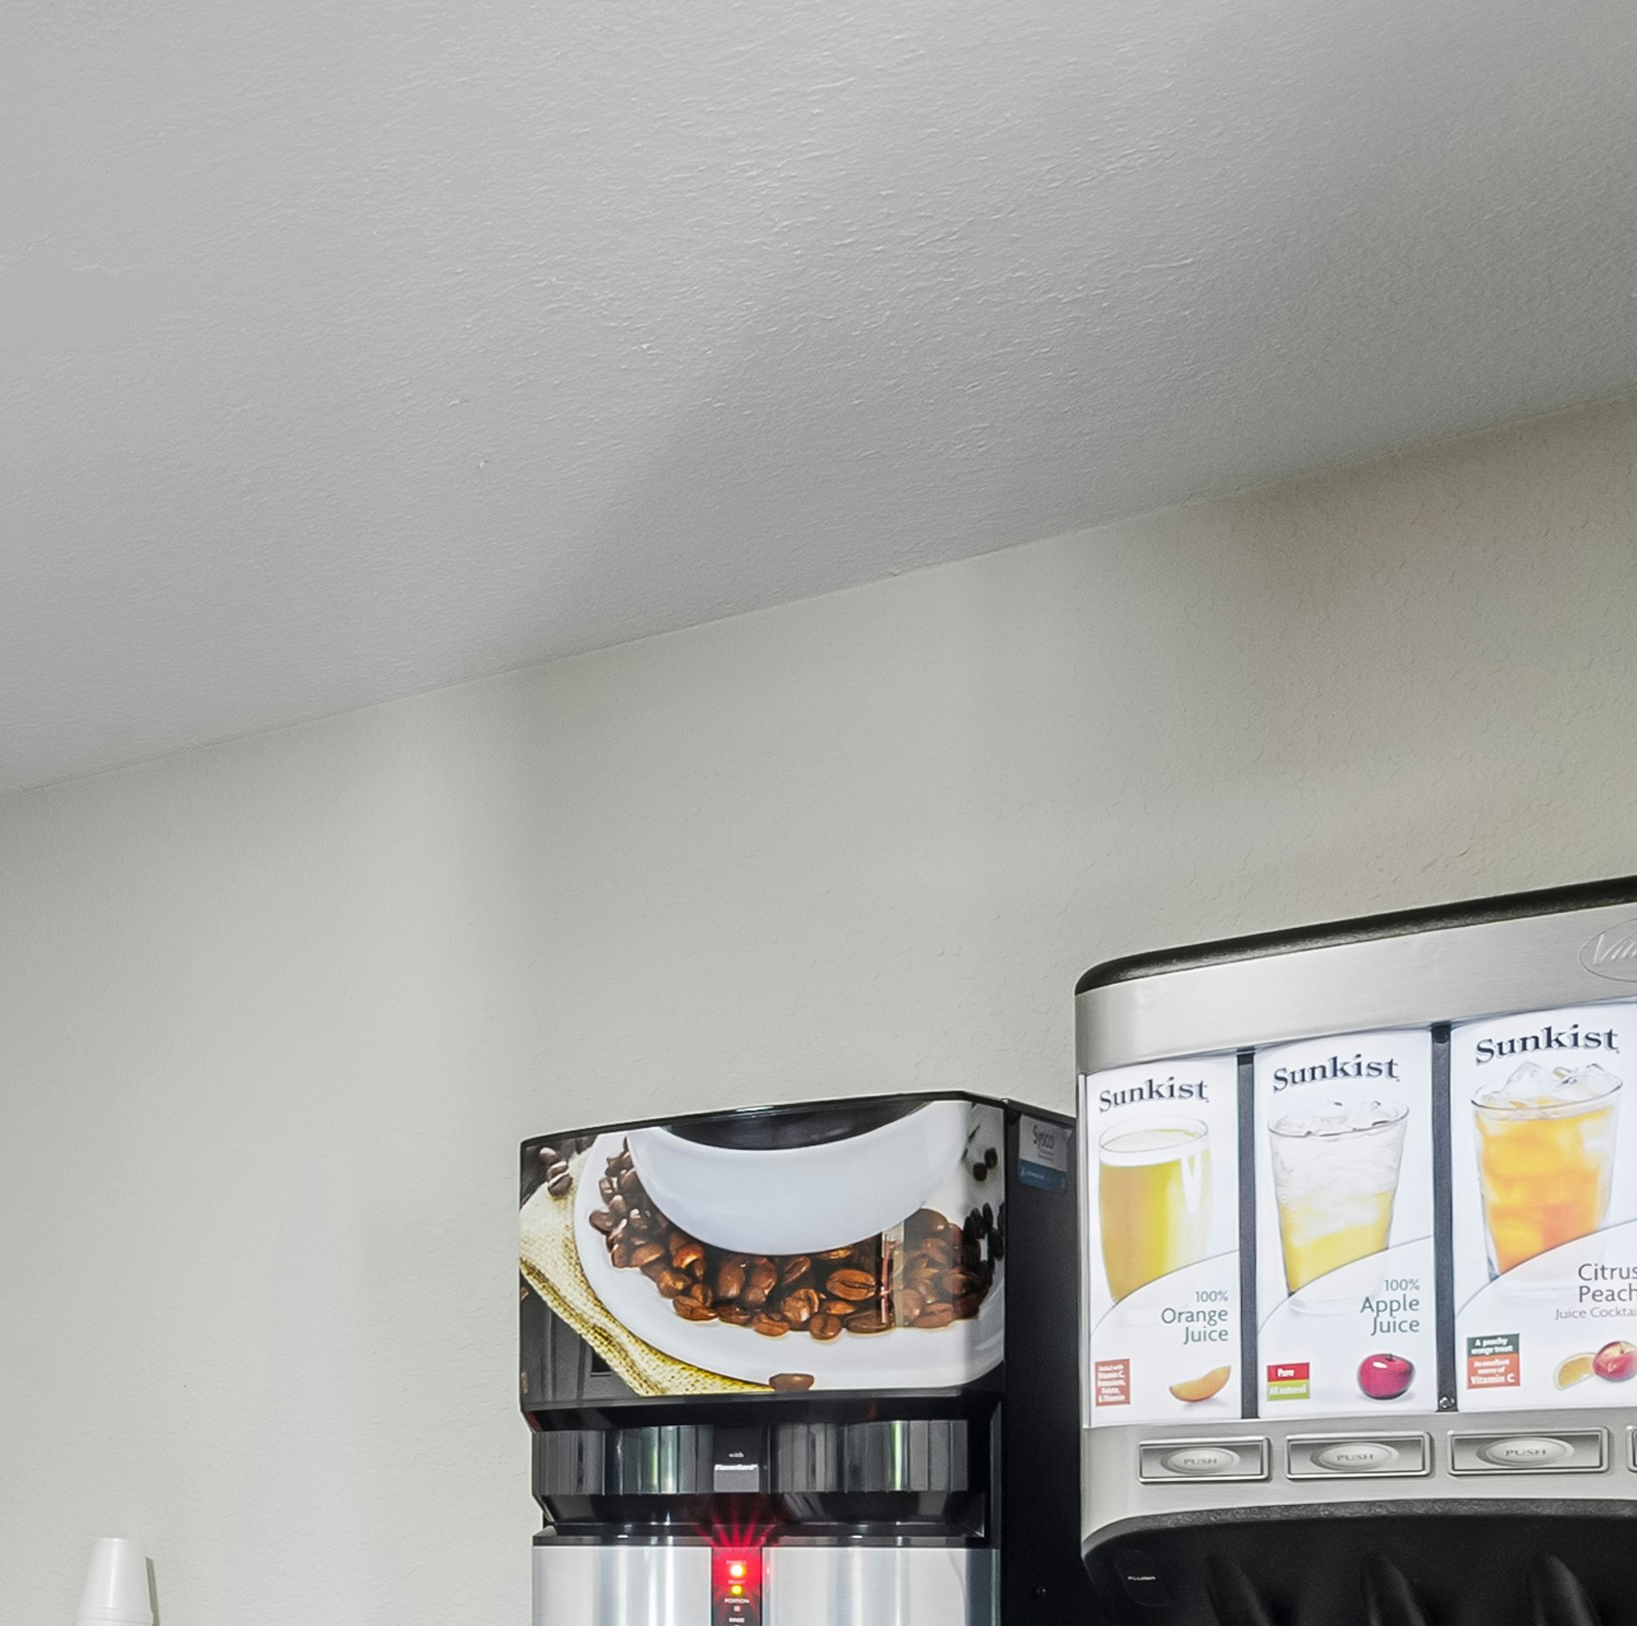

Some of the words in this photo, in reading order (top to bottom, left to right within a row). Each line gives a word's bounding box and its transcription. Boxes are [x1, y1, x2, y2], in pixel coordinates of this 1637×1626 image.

[1476, 1023, 1618, 1064] Sunkist
[1273, 1053, 1399, 1092] Sunkist
[1099, 1076, 1209, 1113] Sunkist
[1578, 1263, 1637, 1281] Citrus
[1384, 1278, 1420, 1291] 100%
[1579, 1283, 1637, 1303] Peach
[1195, 1290, 1228, 1302] 100%
[1360, 1293, 1420, 1317] Apple
[1161, 1307, 1228, 1327] Orange
[1554, 1308, 1587, 1321] Juice
[1183, 1326, 1228, 1345] Juice
[1370, 1316, 1420, 1336] Juice
[1506, 1373, 1515, 1383] C
[1506, 1449, 1547, 1457] PUSH
